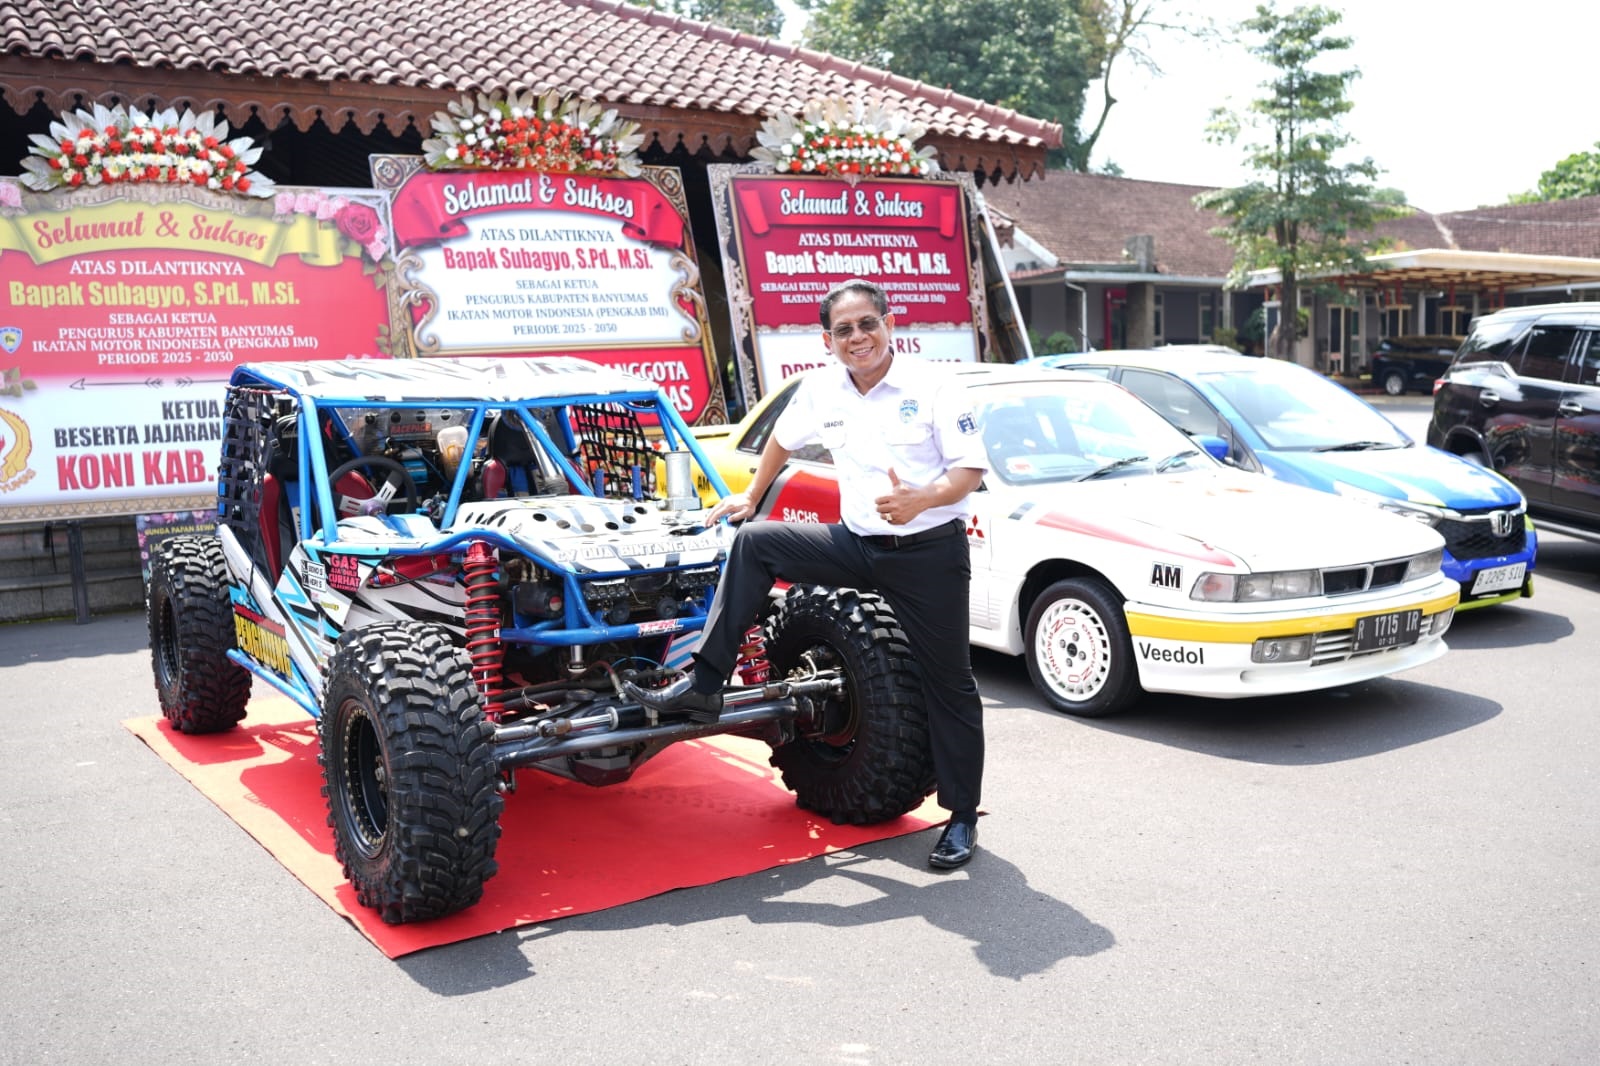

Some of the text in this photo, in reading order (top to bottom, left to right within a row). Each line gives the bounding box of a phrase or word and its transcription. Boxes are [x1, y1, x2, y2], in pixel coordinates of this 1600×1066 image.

[444, 175, 634, 218] Selamat & Sukses
[780, 188, 923, 218] Selamat & Sukses
[34, 211, 268, 250] Selamat & Sukses
[480, 229, 615, 243] ATAS DILANTIKNYA
[799, 233, 918, 248] ATAS DILANTIKNYA
[443, 247, 653, 271] Bapak Subagyo, S.Pd., M.Si.
[765, 251, 950, 276] Bapak Subagyo, S.Pd., M.Si.
[70, 260, 245, 275] ATAS DILANTIKNYA
[516, 279, 599, 289] SEBAGAI KETUA
[761, 283, 797, 292] SEBAGAI
[799, 282, 828, 292] KETUA
[918, 282, 960, 292] BANYUMAS
[10, 281, 300, 308] Bapak Subagyo, S.Pd., M.Si.
[465, 293, 649, 305] PENGURUS KABUPATEN BANYUMAS
[782, 294, 820, 303] IKATAN
[109, 312, 217, 325] SEBAGAI KETUA
[447, 307, 669, 320] IKATAN MOTOR INDONESIA (PENGKAB IMI)
[59, 325, 294, 339] PENGURUS KABUPATEN BANYUMAS
[513, 324, 561, 335] PERIODE
[562, 323, 586, 334] 2025
[594, 323, 617, 334] 2030
[32, 336, 319, 352] IKATAN MOTOR INDONESIA (PENGKAB IMI)
[98, 352, 159, 365] PERIODE
[162, 351, 192, 363] 2025
[204, 351, 233, 362] 2030
[604, 361, 690, 383] NGGOTA
[162, 400, 220, 420] KETUA
[54, 420, 221, 448] BESERTA JAJARAN
[56, 449, 214, 491] KONI KAB.
[783, 507, 819, 523] SACHS
[620, 541, 686, 557] BINTANG
[331, 554, 358, 570] GAS
[329, 573, 361, 587] CURHAT
[1151, 563, 1181, 589] AM
[1358, 611, 1419, 640] R 1715 IR
[1139, 642, 1204, 665] Veedol
